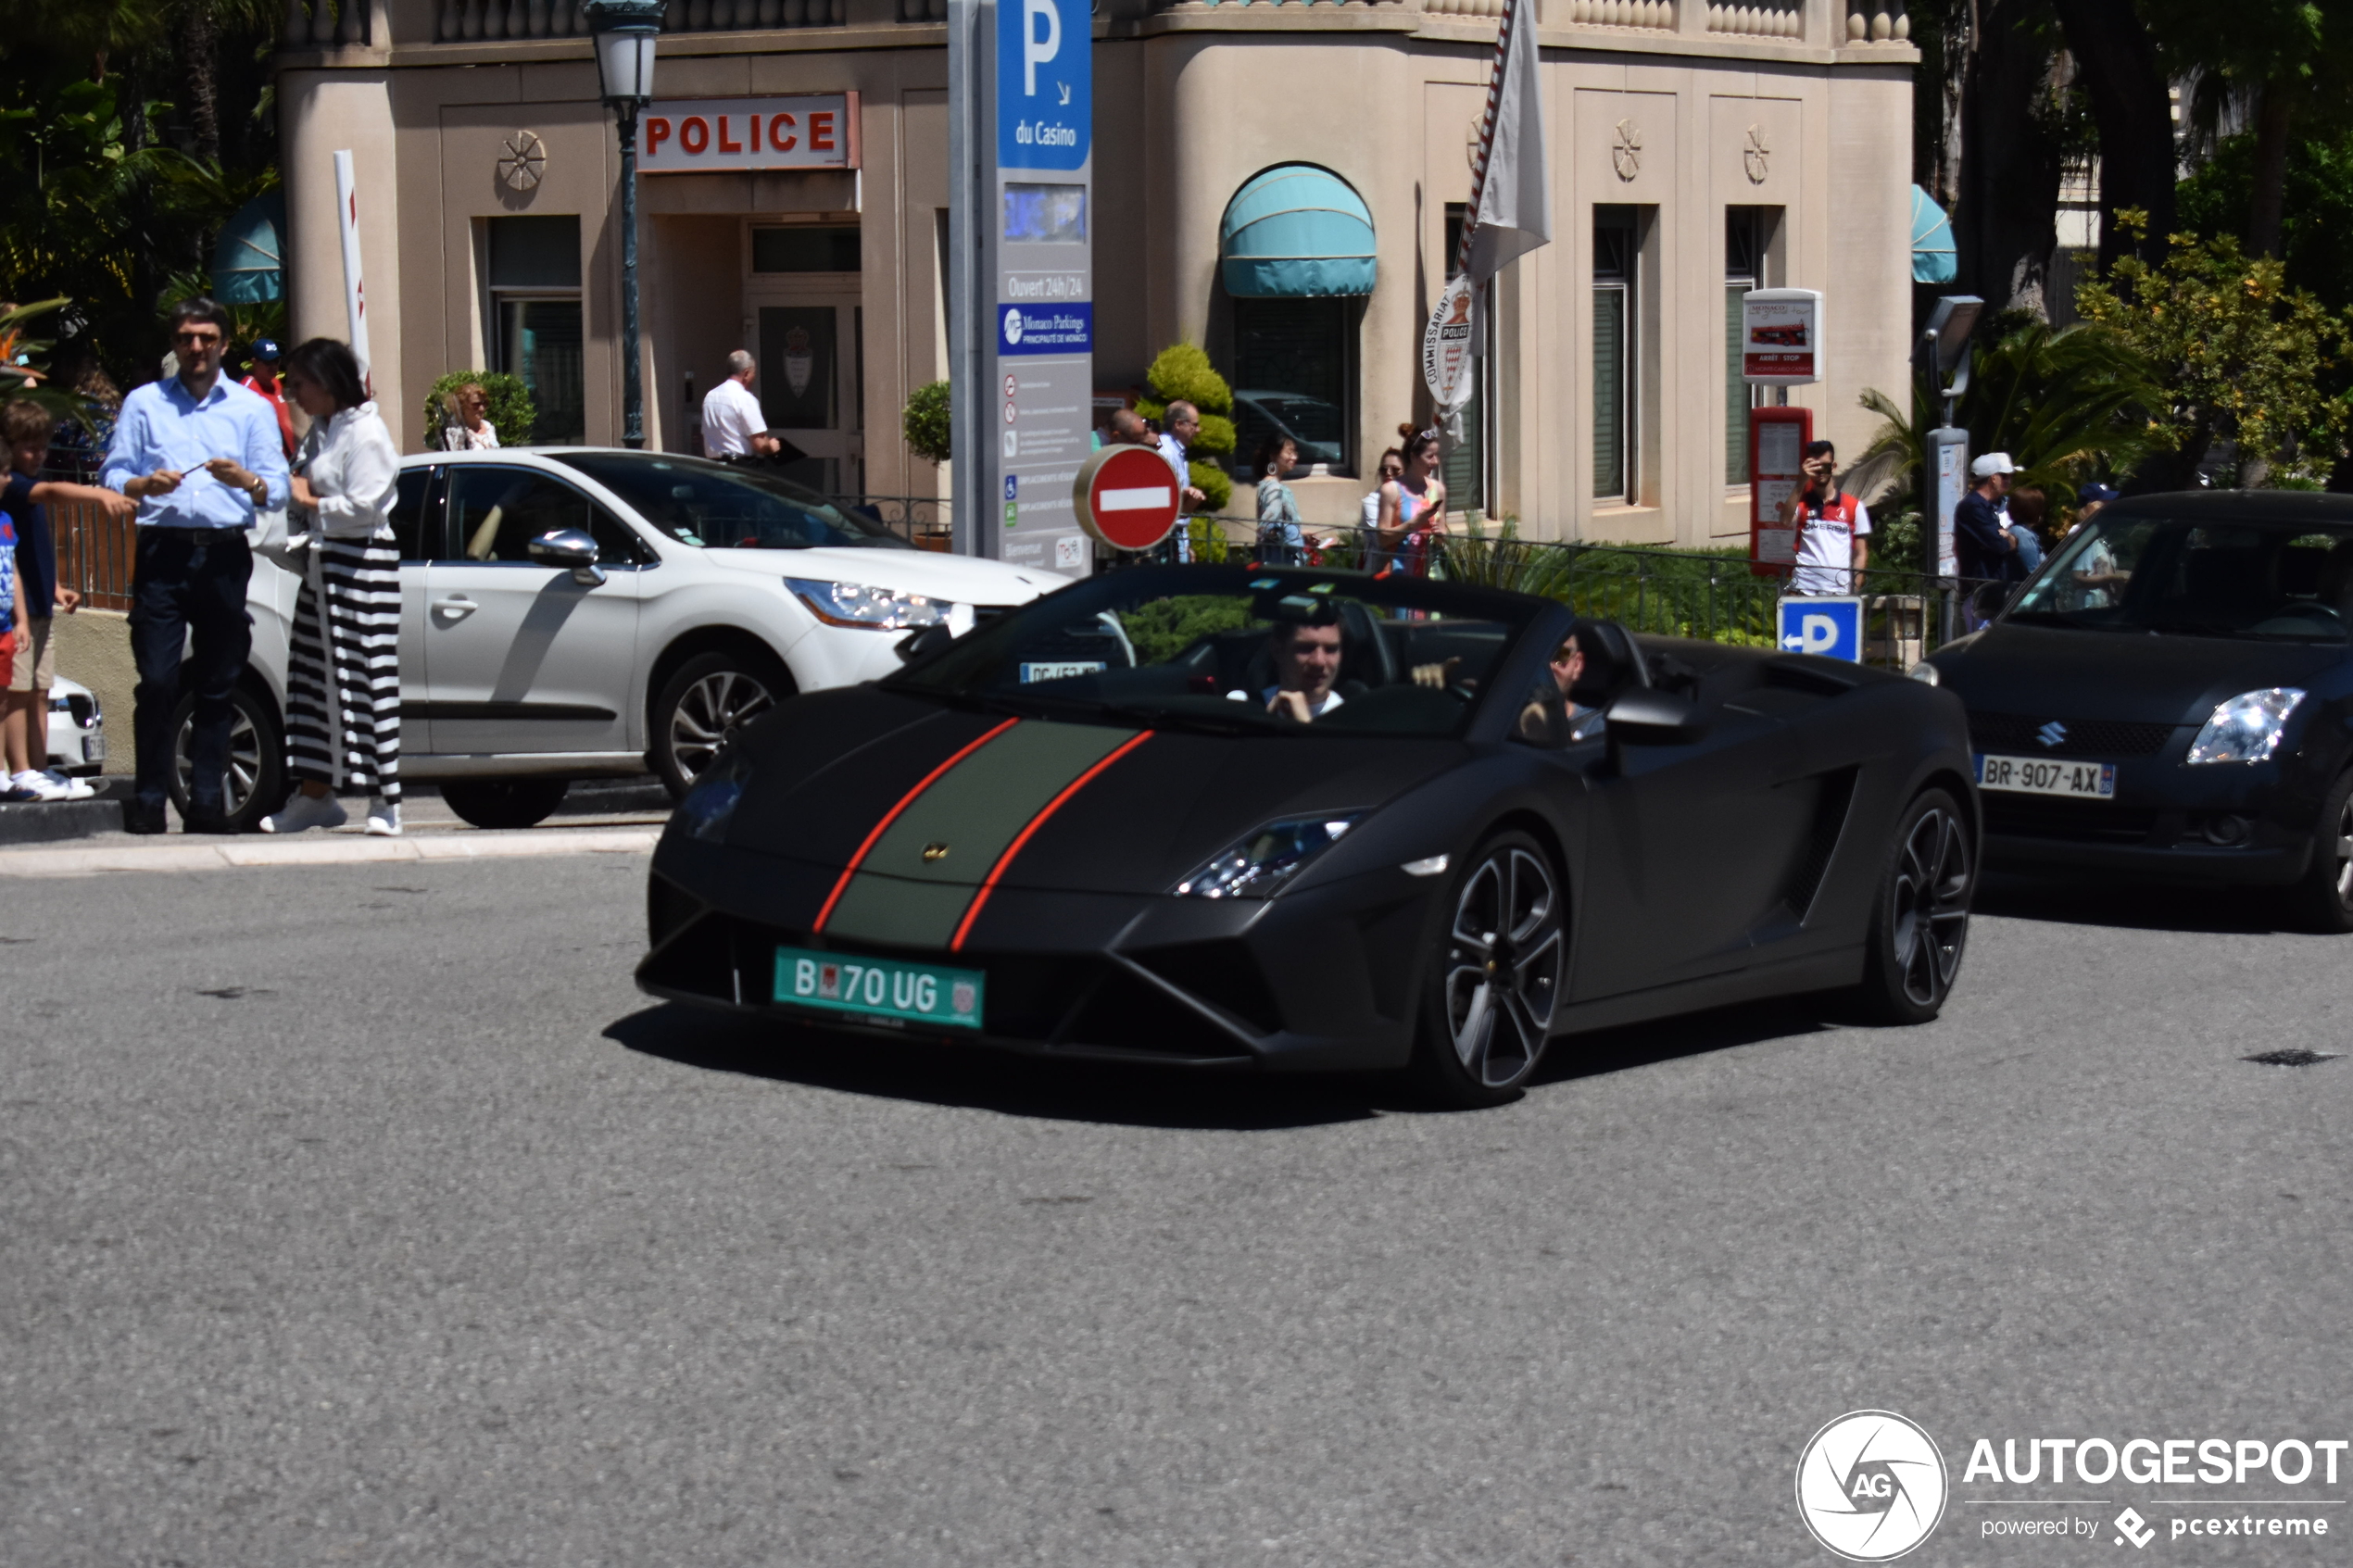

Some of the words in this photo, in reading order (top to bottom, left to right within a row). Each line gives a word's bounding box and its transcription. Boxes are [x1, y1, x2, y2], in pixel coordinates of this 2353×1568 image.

[1024, 0, 1062, 96] P
[647, 112, 835, 155] POLICE
[1016, 119, 1032, 144] du
[1035, 121, 1076, 146] Casino
[1008, 277, 1044, 297] Ouvert
[1045, 275, 1083, 299] 24h/24
[1023, 315, 1052, 330] Monaco
[1053, 314, 1085, 333] Parkings
[1425, 295, 1451, 385] COMMISSARIAT
[1442, 326, 1467, 338] POLICE
[1759, 353, 1778, 361] ARRÊT
[1802, 614, 1838, 654] P
[1984, 759, 2098, 793] BR-907-AX
[794, 958, 816, 997] B
[843, 964, 886, 1006] 70
[893, 971, 937, 1012] UG
